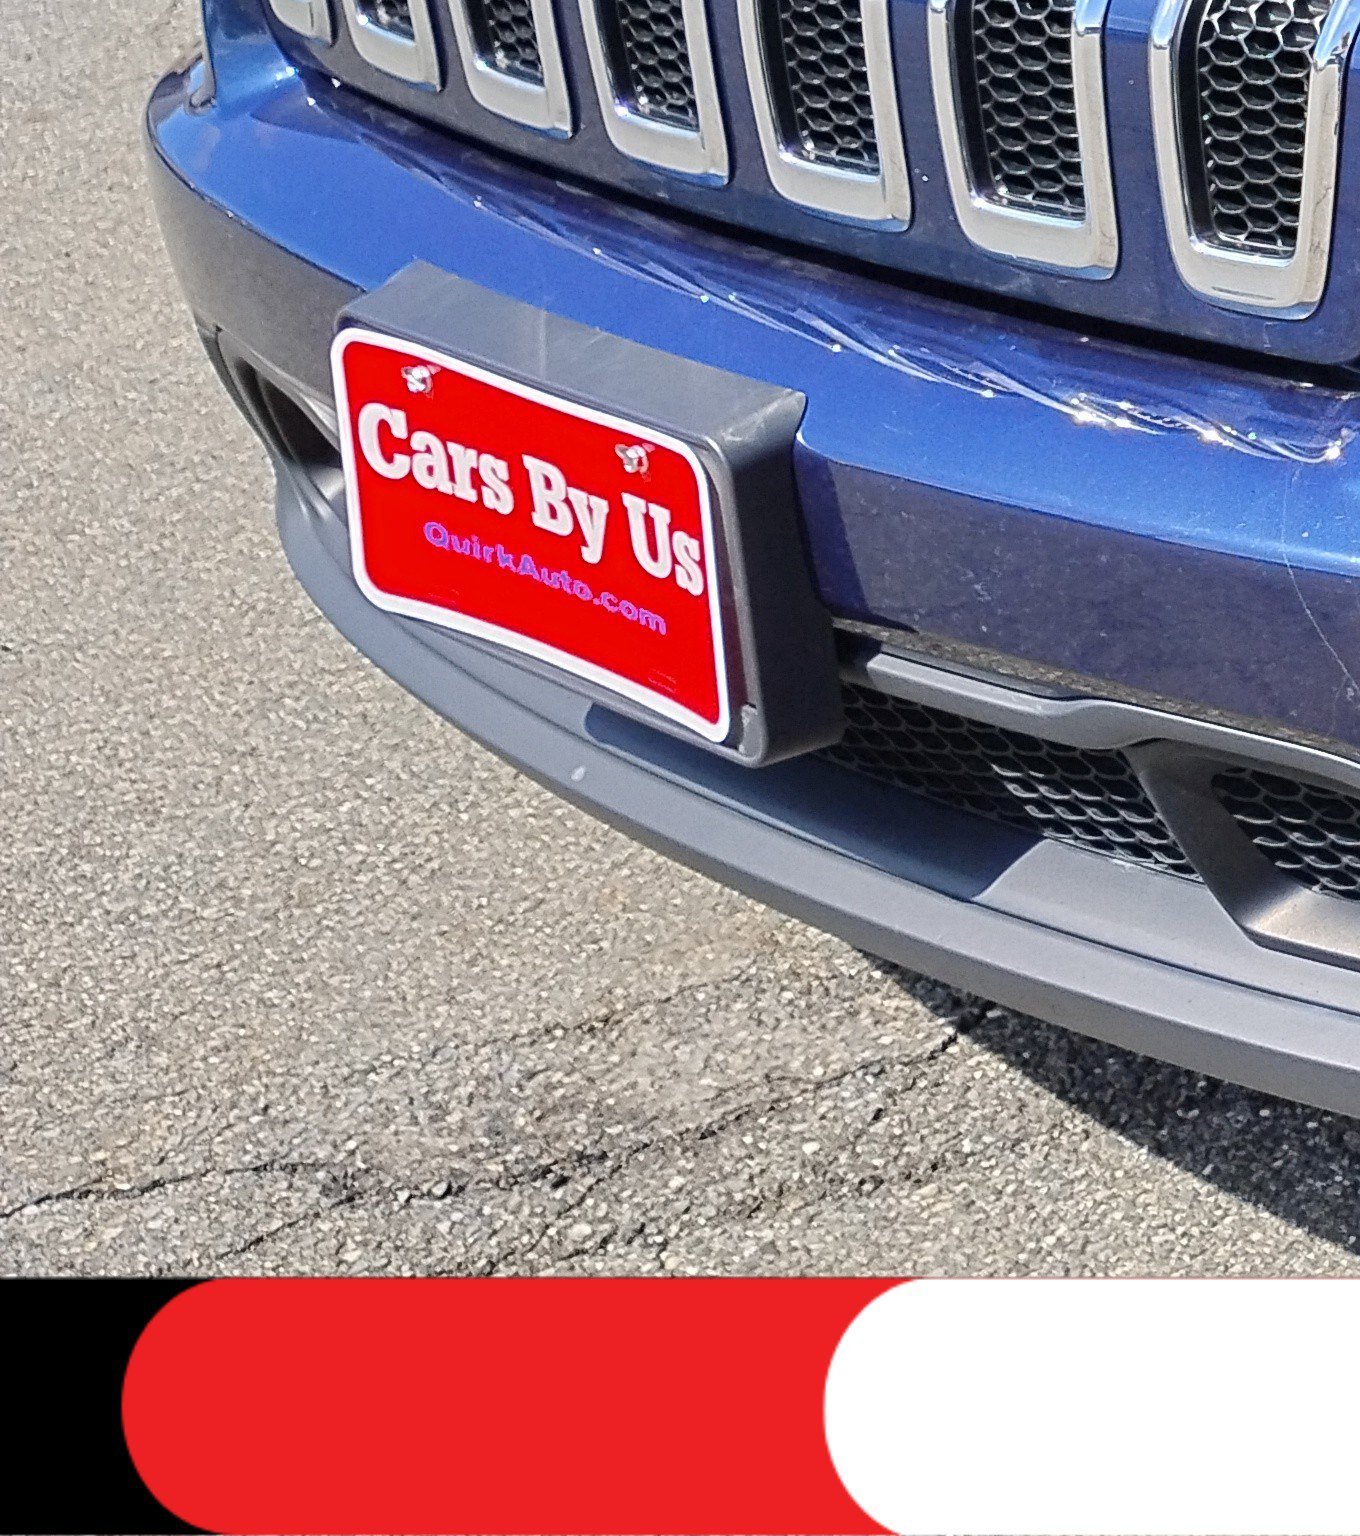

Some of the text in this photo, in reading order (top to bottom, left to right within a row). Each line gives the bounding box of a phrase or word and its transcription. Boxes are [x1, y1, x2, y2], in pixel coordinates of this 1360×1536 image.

[358, 402, 705, 597] Cars By Us
[423, 521, 667, 636] QuirkAuto.com
